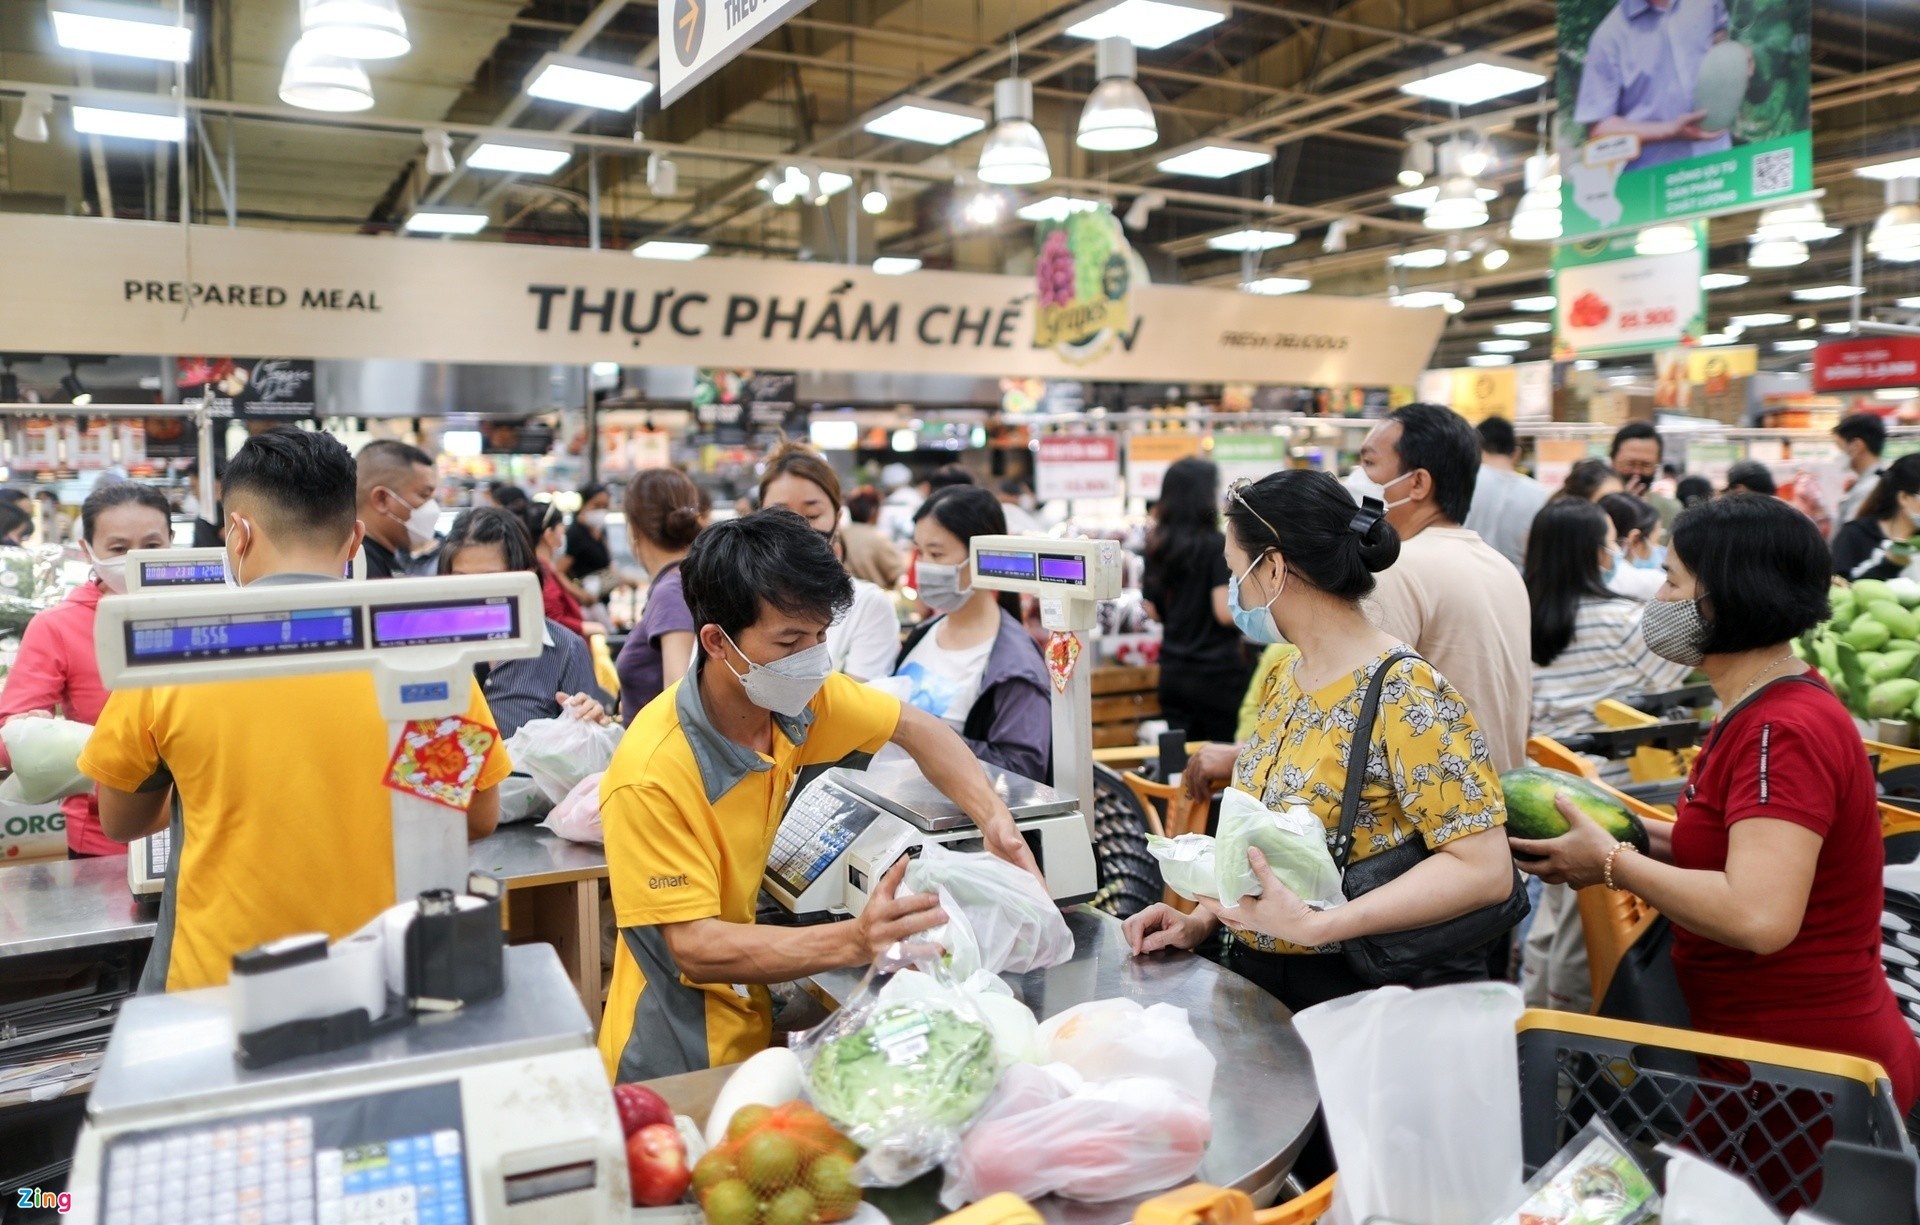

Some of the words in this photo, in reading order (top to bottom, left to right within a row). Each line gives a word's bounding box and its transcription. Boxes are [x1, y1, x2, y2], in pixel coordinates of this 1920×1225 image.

[124, 280, 287, 306] PREPARED
[301, 288, 382, 312] MEAL
[528, 284, 708, 347] THỰC
[648, 873, 690, 889] emart
